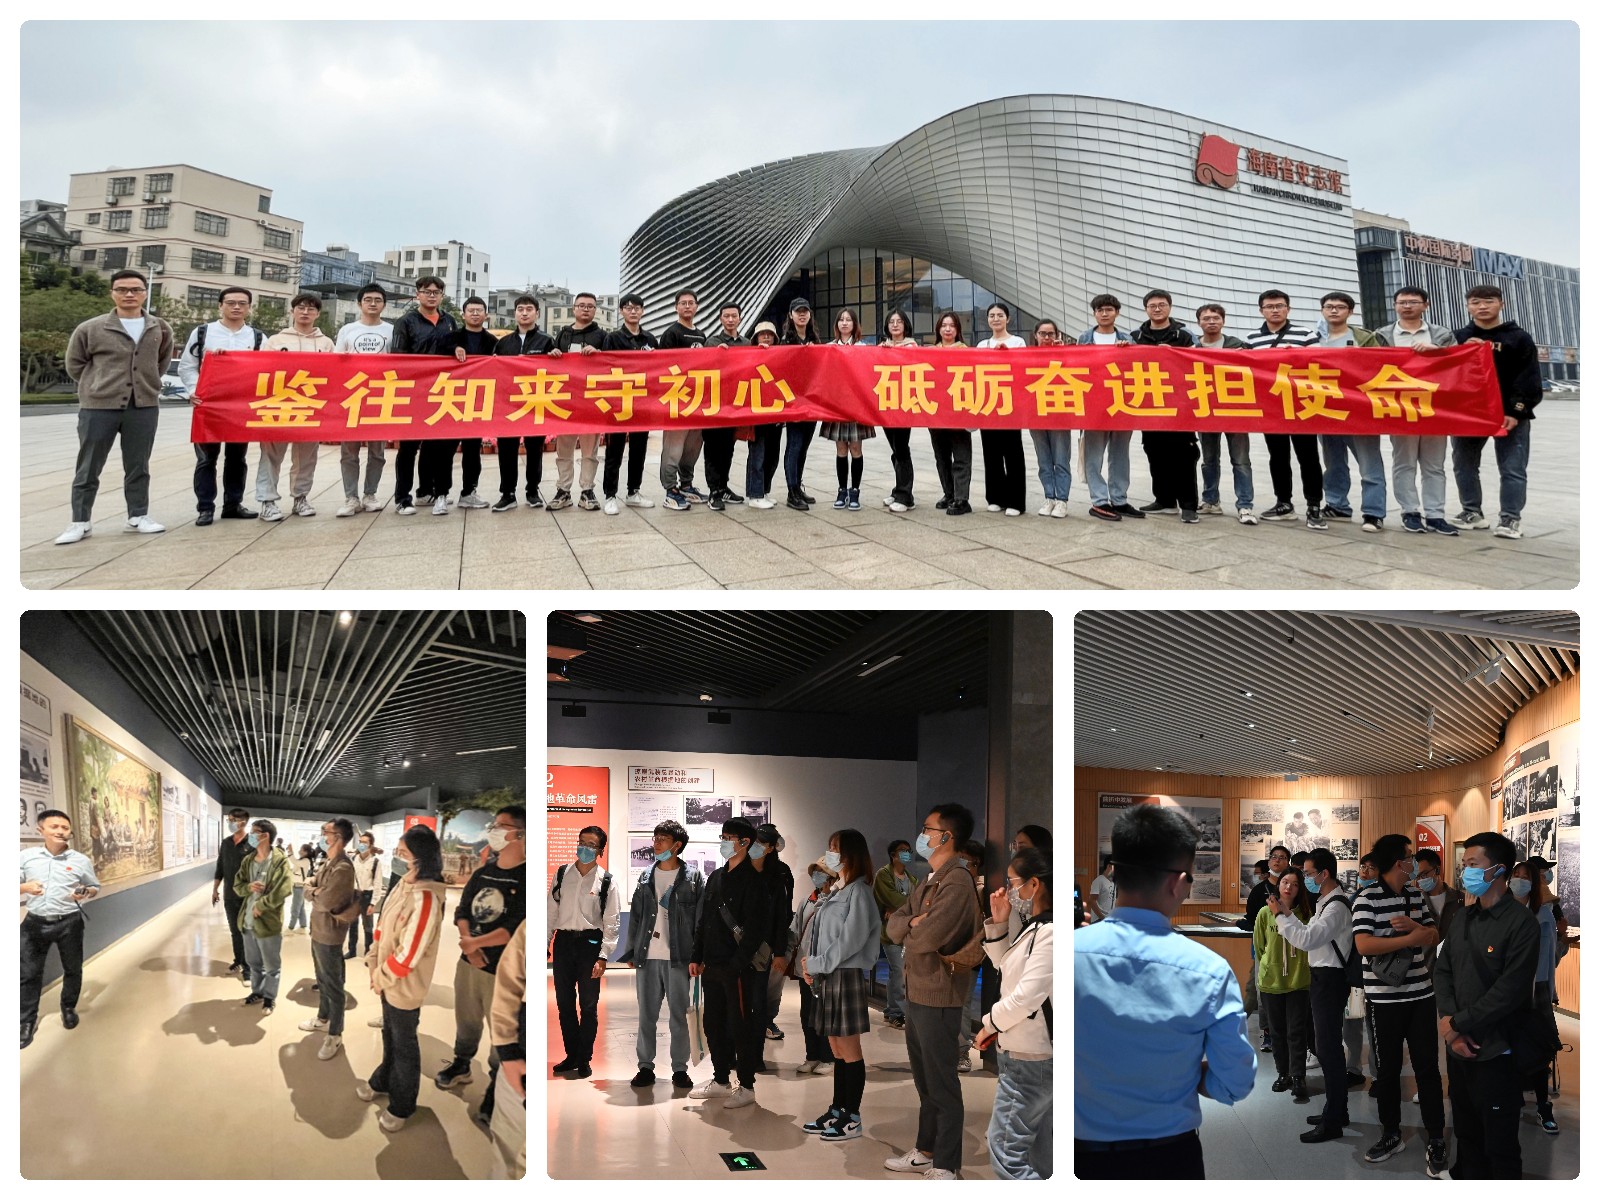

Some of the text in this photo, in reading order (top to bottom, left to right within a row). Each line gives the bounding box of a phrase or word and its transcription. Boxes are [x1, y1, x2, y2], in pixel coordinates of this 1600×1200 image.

[1246, 148, 1343, 195] 海南省史志馆
[1474, 247, 1524, 279] IMAX
[246, 361, 1441, 428] 鉴往知来守初心 砥砺奋进担使命
[1418, 833, 1428, 842] 02
